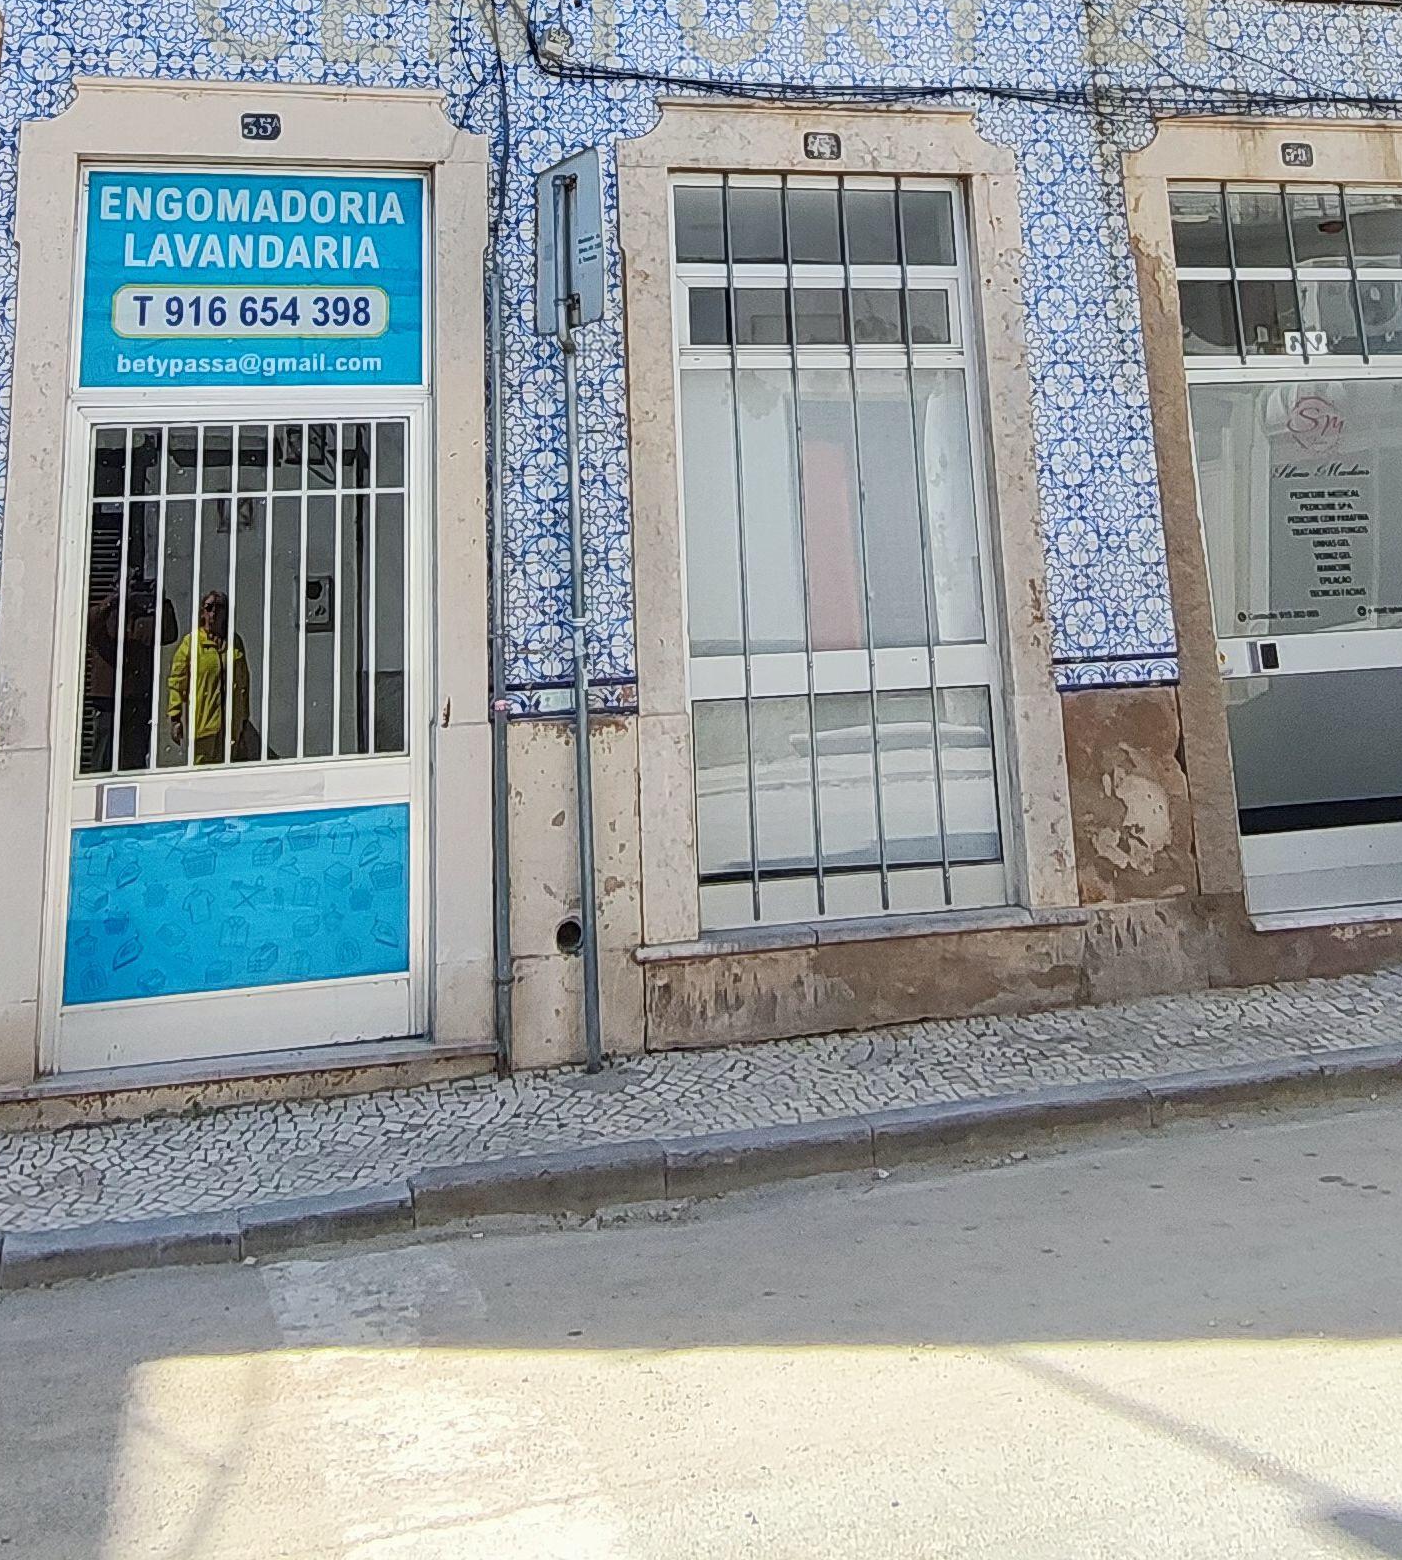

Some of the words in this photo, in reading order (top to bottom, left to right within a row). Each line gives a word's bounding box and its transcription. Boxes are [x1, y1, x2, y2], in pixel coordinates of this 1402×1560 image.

[99, 186, 405, 225] ENGOMADORIA
[123, 233, 380, 269] LAVANDARIA
[133, 297, 154, 327] T
[165, 297, 227, 327] 916
[239, 297, 300, 327] 654
[312, 297, 371, 327] 398
[116, 353, 383, 377] betypassa@gmail.com
